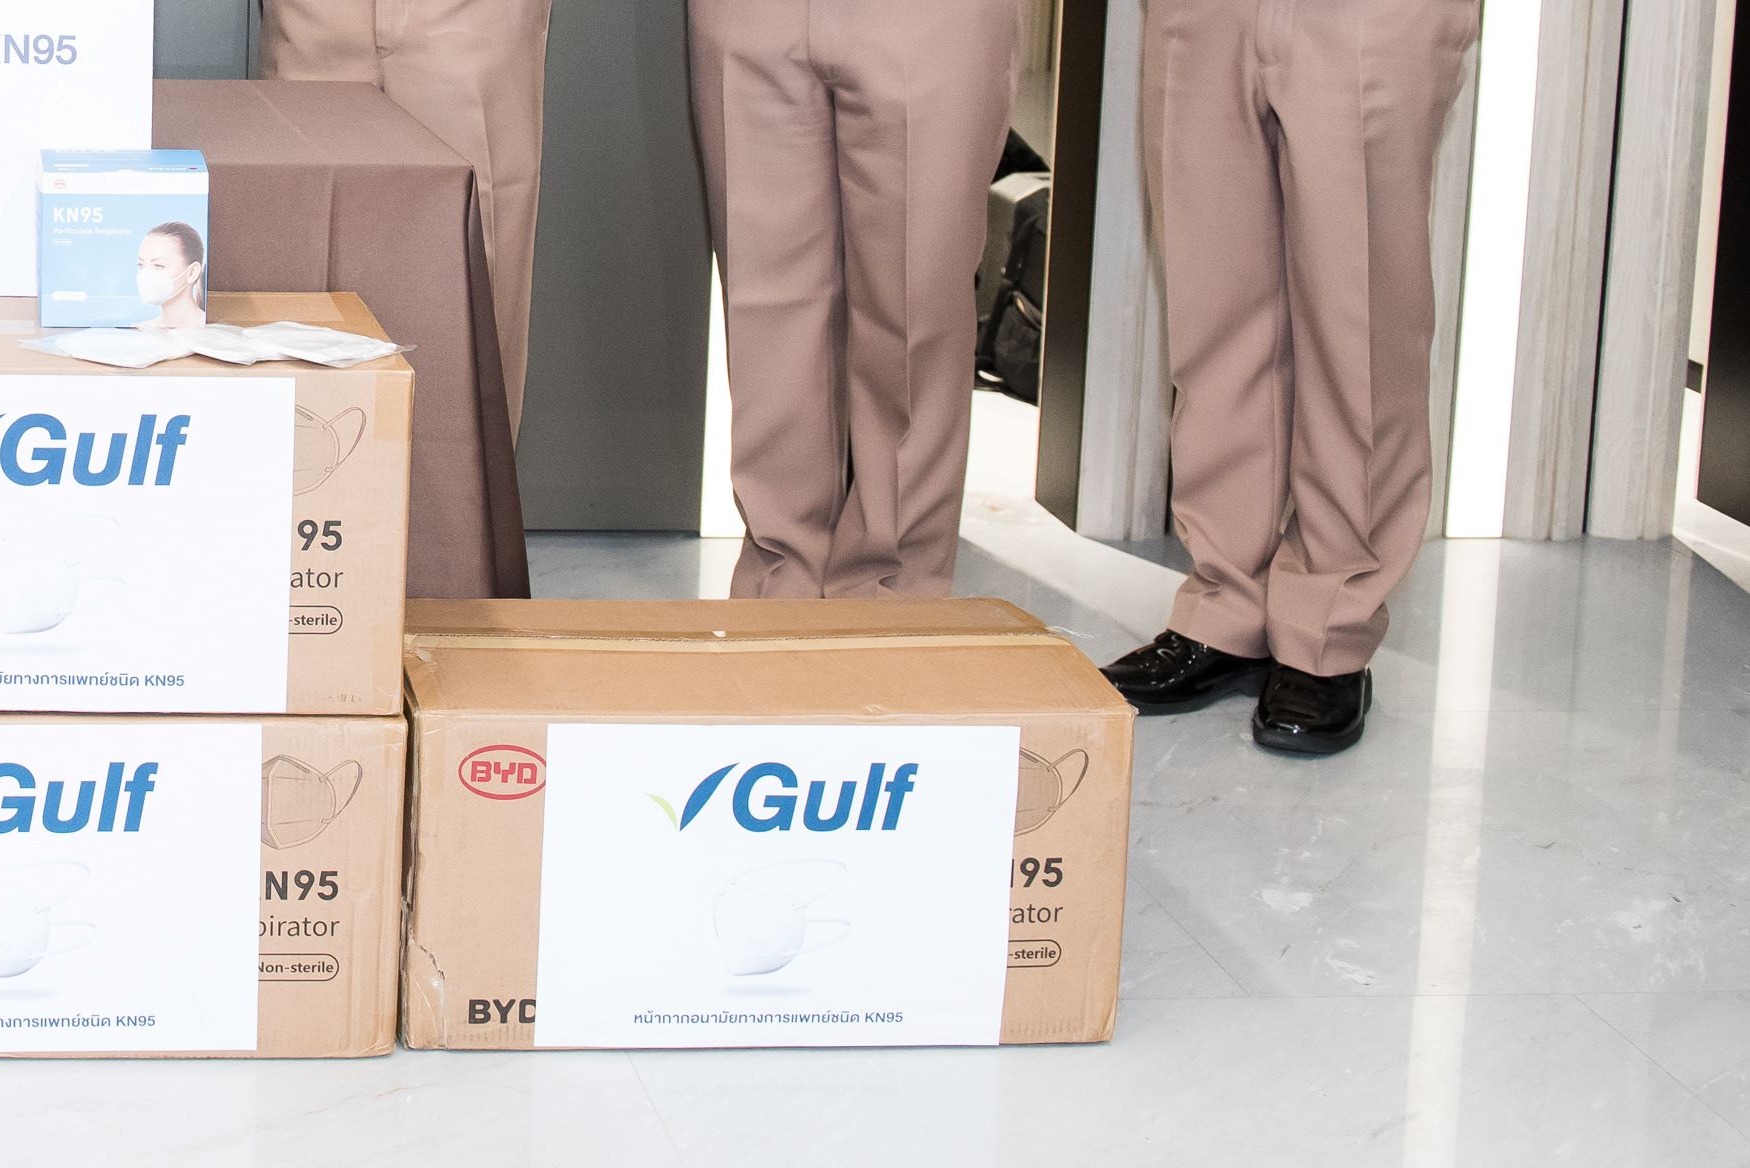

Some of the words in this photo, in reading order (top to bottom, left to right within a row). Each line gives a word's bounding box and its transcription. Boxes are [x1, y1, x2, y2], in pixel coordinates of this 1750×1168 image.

[53, 207, 103, 223] KN95
[0, 413, 191, 487] Gulf
[297, 519, 343, 551] 95
[145, 675, 185, 687] KN95
[469, 760, 537, 784] BYD
[732, 762, 919, 833] Gulf
[1010, 857, 1063, 888] 95
[260, 870, 339, 901] N95
[1010, 904, 1064, 924] ator
[116, 1015, 156, 1028] KN95
[469, 999, 537, 1025] BYD
[634, 1010, 860, 1025] หน้ากากอนามัยทางการแพทย์ชนิด
[865, 1011, 904, 1024] KN95
